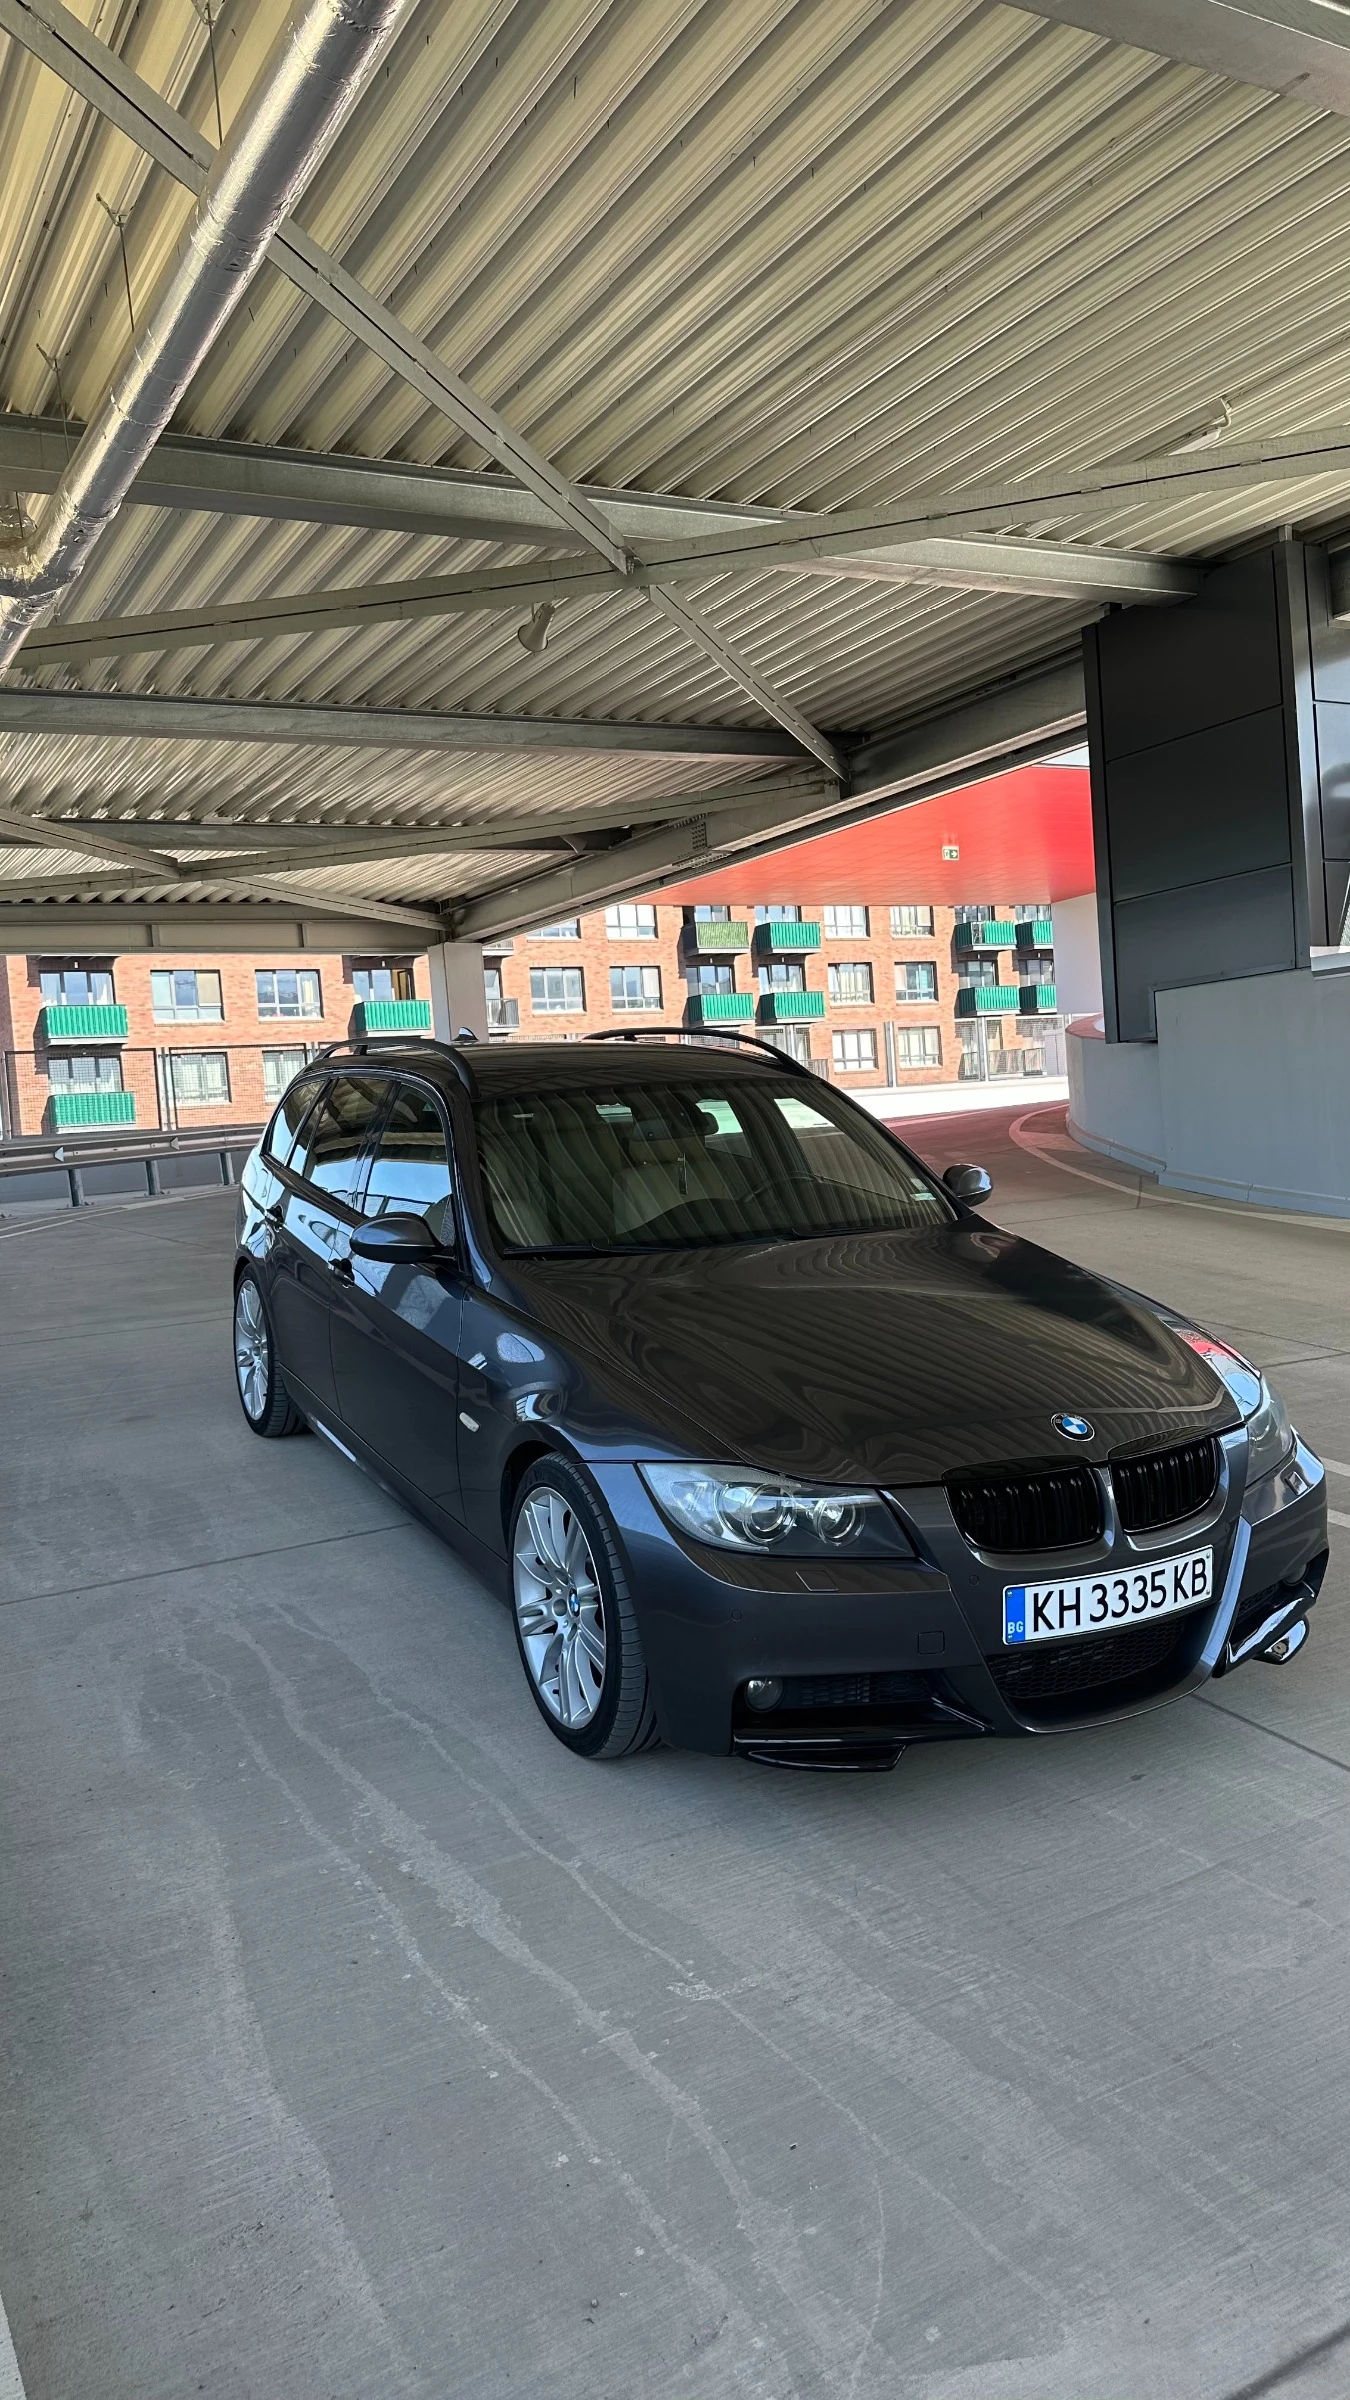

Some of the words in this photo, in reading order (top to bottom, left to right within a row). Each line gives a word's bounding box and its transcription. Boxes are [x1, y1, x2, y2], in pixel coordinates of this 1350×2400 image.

[1033, 1587, 1081, 1633] KH
[1089, 1568, 1167, 1623] 3335
[1173, 1557, 1207, 1604] KB
[1007, 1620, 1024, 1635] BG
